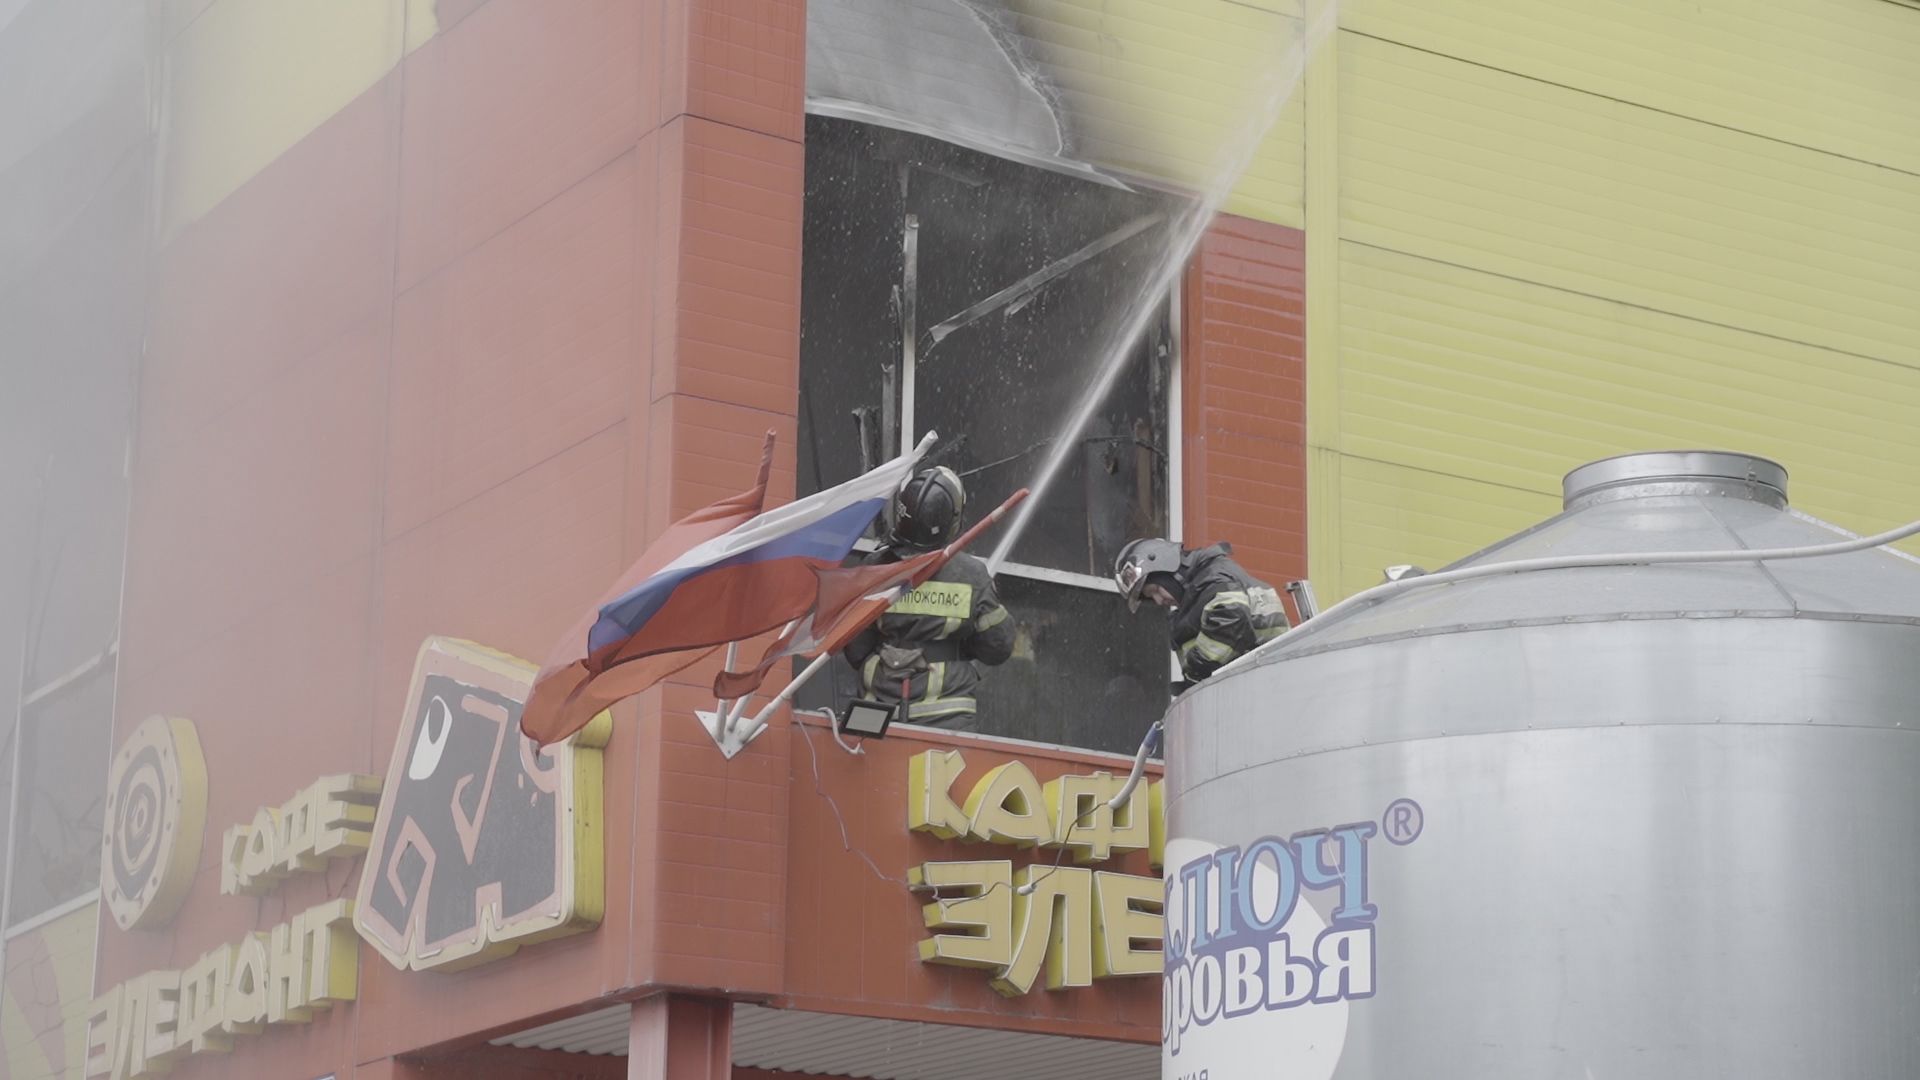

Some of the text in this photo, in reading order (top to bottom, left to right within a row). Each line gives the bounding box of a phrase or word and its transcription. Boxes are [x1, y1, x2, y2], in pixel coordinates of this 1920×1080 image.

[221, 772, 378, 896] КАФЕ
[909, 749, 1164, 864] КАФ
[84, 898, 356, 1080] ЭЛЕФАНТ
